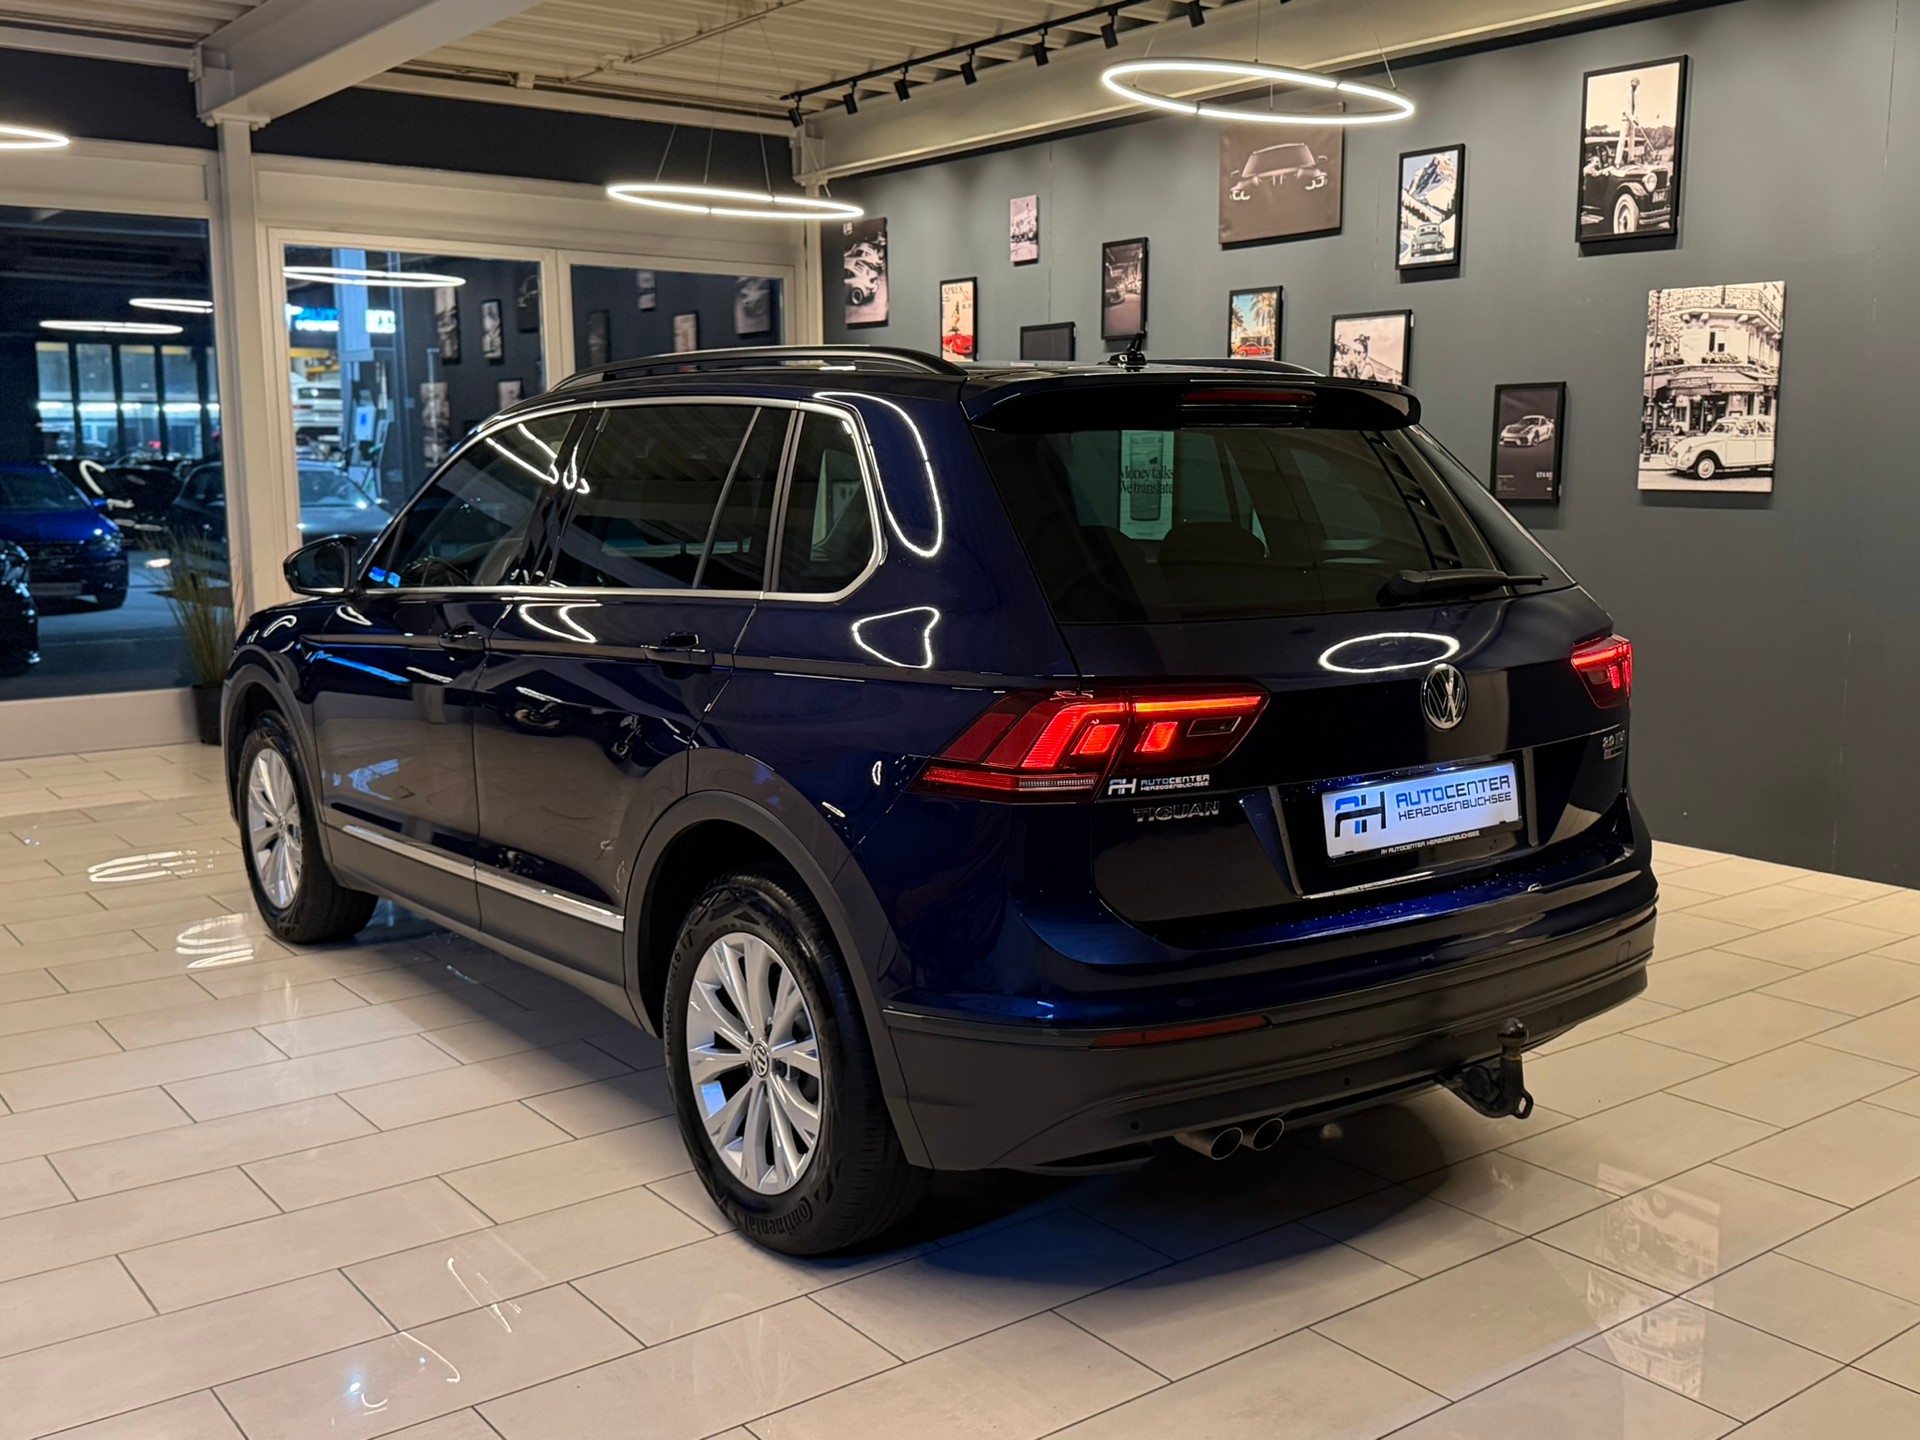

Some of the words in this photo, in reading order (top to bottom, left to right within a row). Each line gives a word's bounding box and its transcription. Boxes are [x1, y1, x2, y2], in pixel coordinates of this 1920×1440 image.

[1140, 774, 1210, 786] AUTOCENTER
[1395, 775, 1511, 809] AUTOCENTER
[1132, 800, 1220, 822] TIGUAN
[1398, 792, 1512, 821] HERZOGENBUCHSEE
[744, 1196, 814, 1236] Continental
